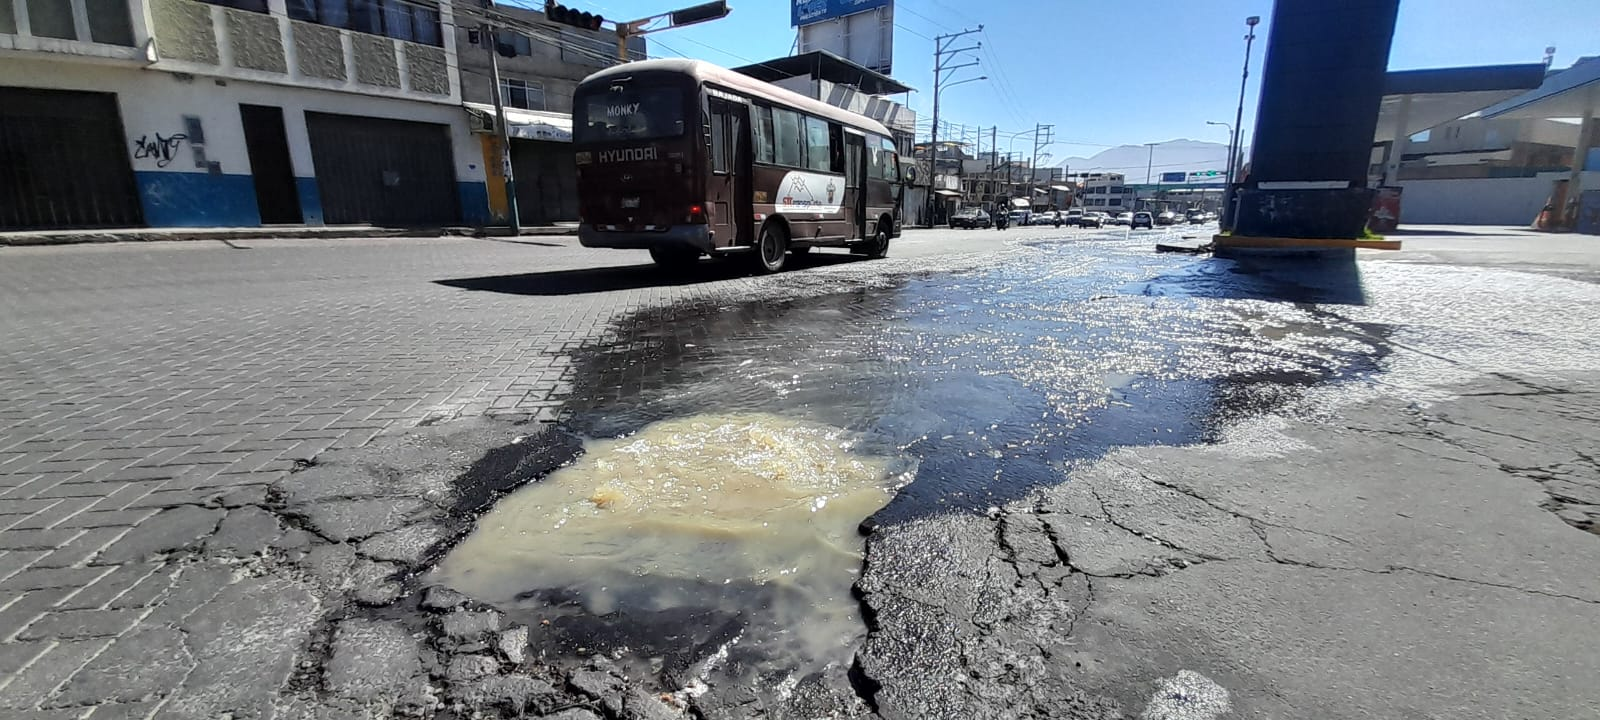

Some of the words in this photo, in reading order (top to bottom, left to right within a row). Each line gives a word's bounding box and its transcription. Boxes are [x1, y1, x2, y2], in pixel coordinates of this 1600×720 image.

[712, 88, 743, 103] BAJADA
[607, 102, 640, 117] MONKY
[598, 146, 658, 164] HYUNDAI
